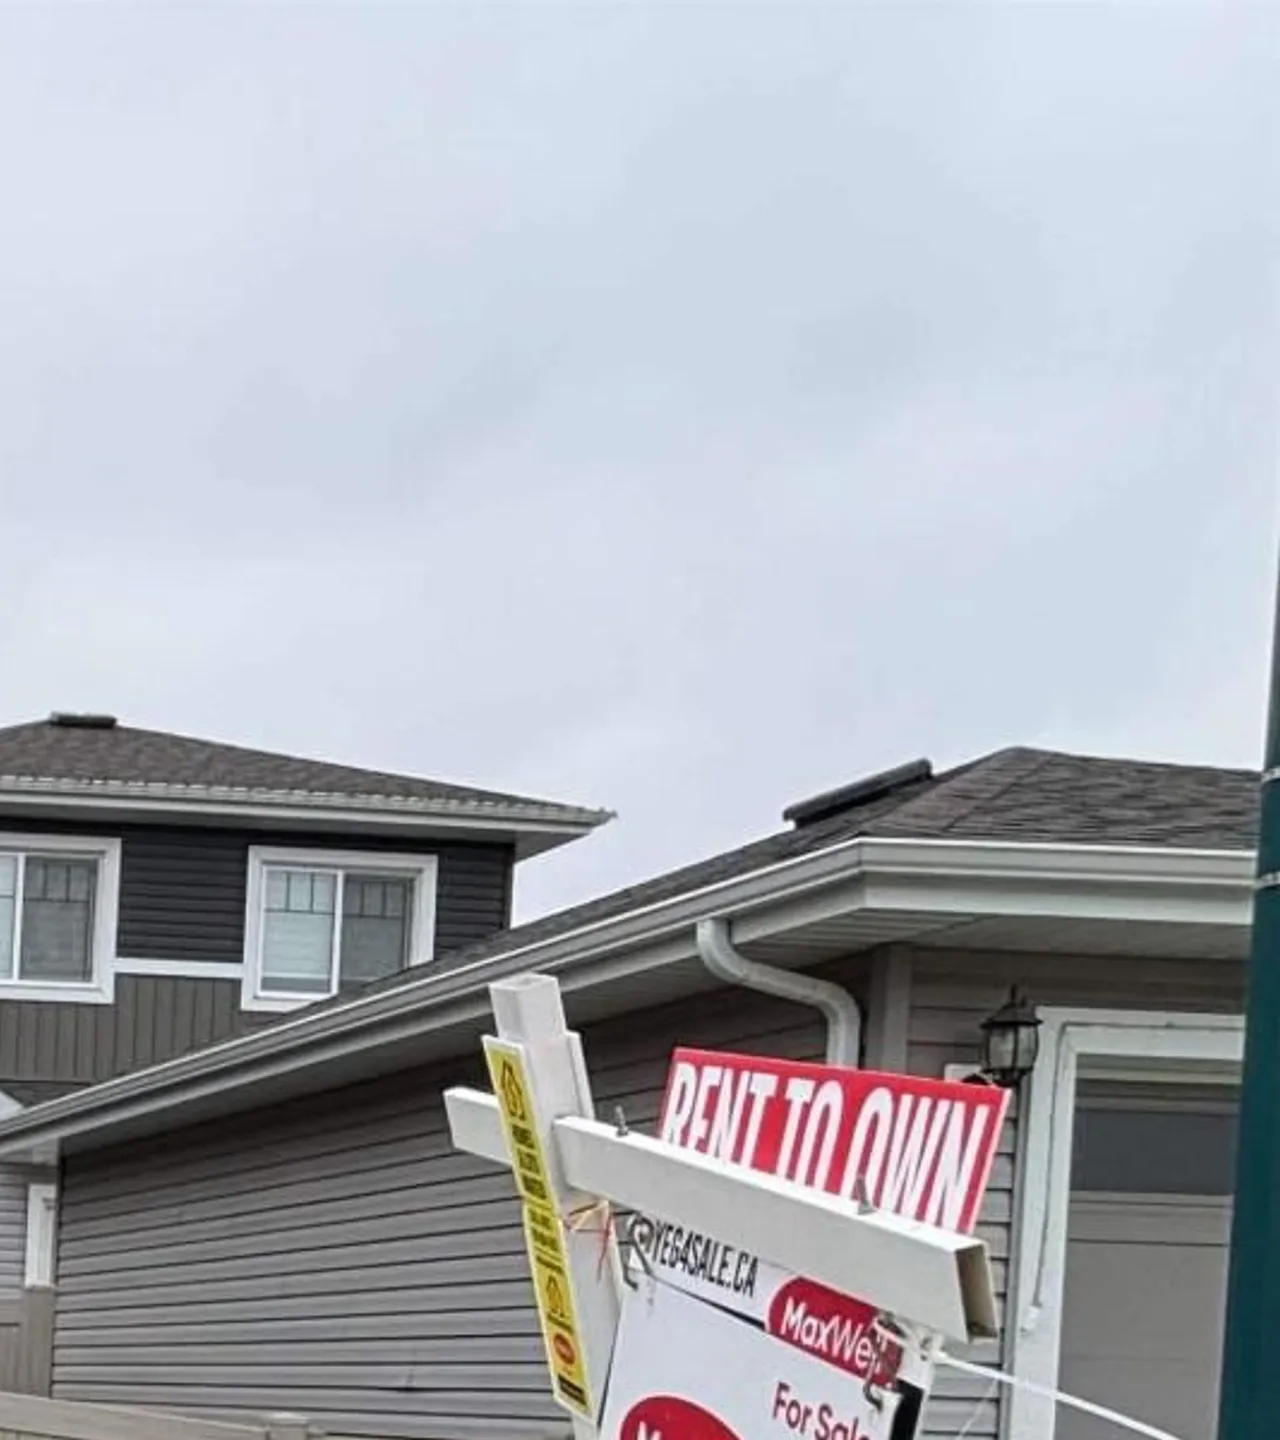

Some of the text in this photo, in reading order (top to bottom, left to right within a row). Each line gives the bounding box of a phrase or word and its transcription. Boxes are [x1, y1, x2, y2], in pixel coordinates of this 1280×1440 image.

[661, 1062, 779, 1175] RENT
[775, 1077, 845, 1195] TO
[840, 1086, 992, 1235] OWN
[772, 1382, 813, 1435] For
